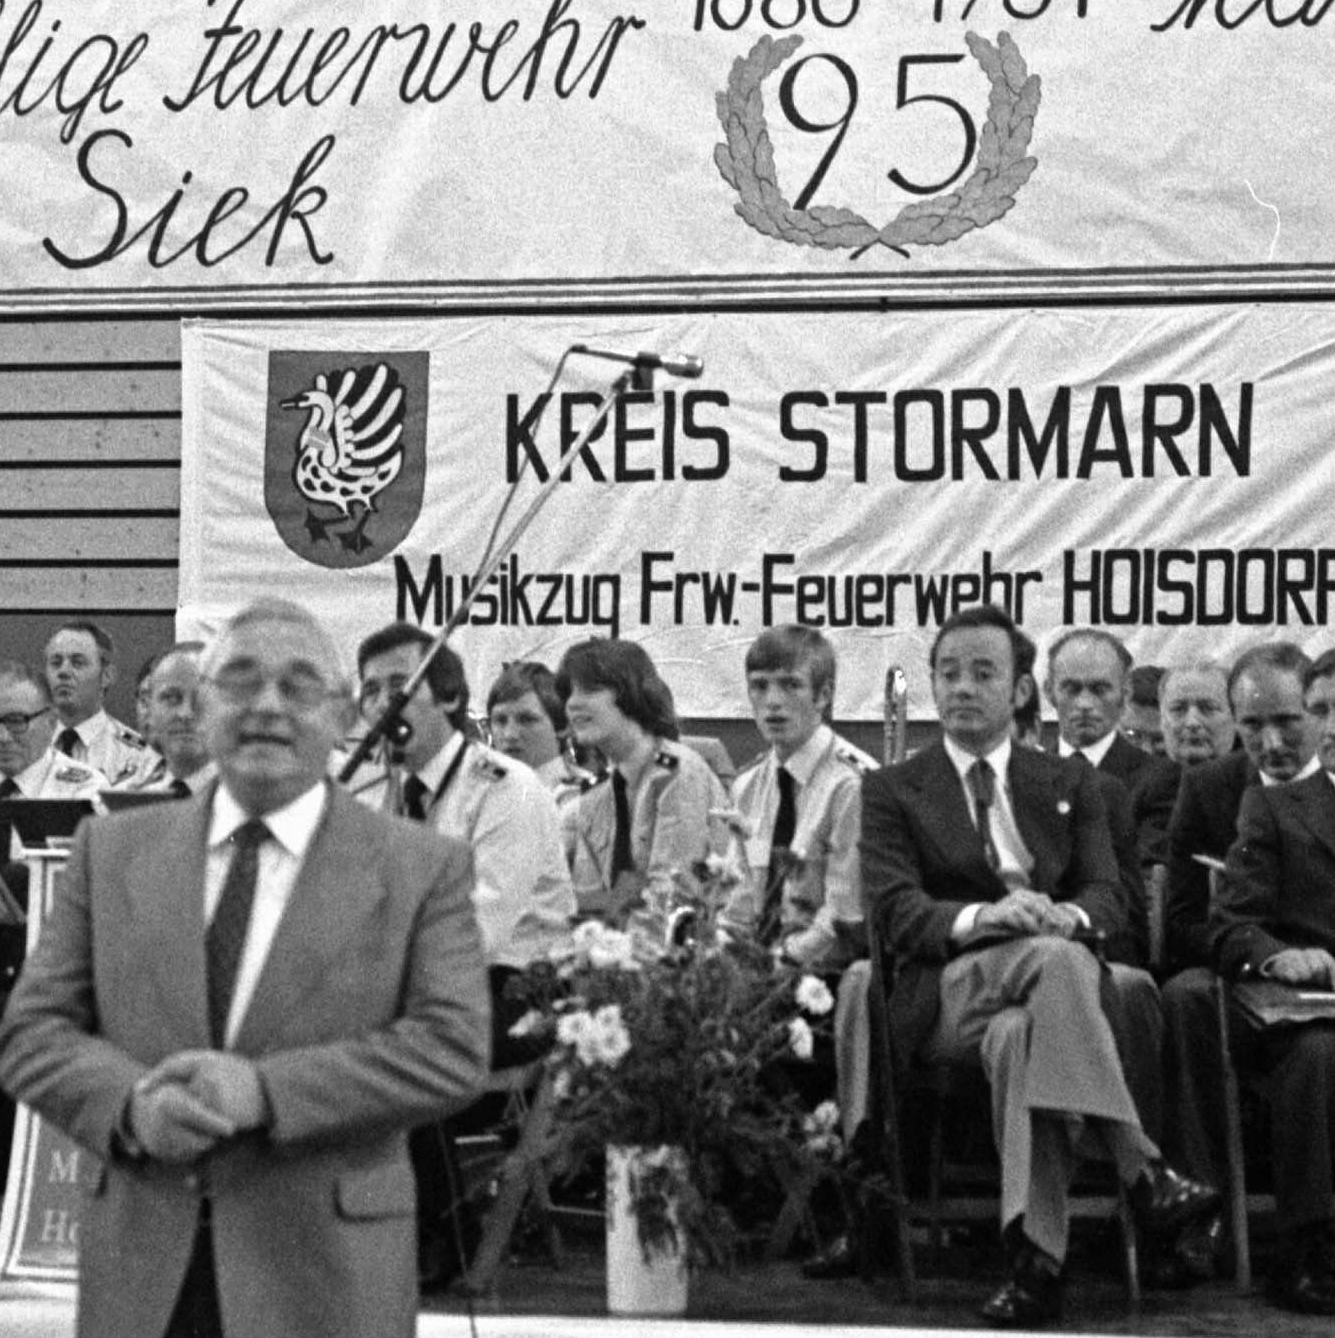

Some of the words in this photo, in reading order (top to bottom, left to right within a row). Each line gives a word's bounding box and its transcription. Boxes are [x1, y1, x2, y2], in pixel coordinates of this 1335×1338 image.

[778, 52, 977, 210] 95
[43, 129, 334, 269] Siek
[506, 389, 730, 483] KREIS
[778, 381, 1256, 484] STORMARN
[393, 551, 621, 638] Musikzug
